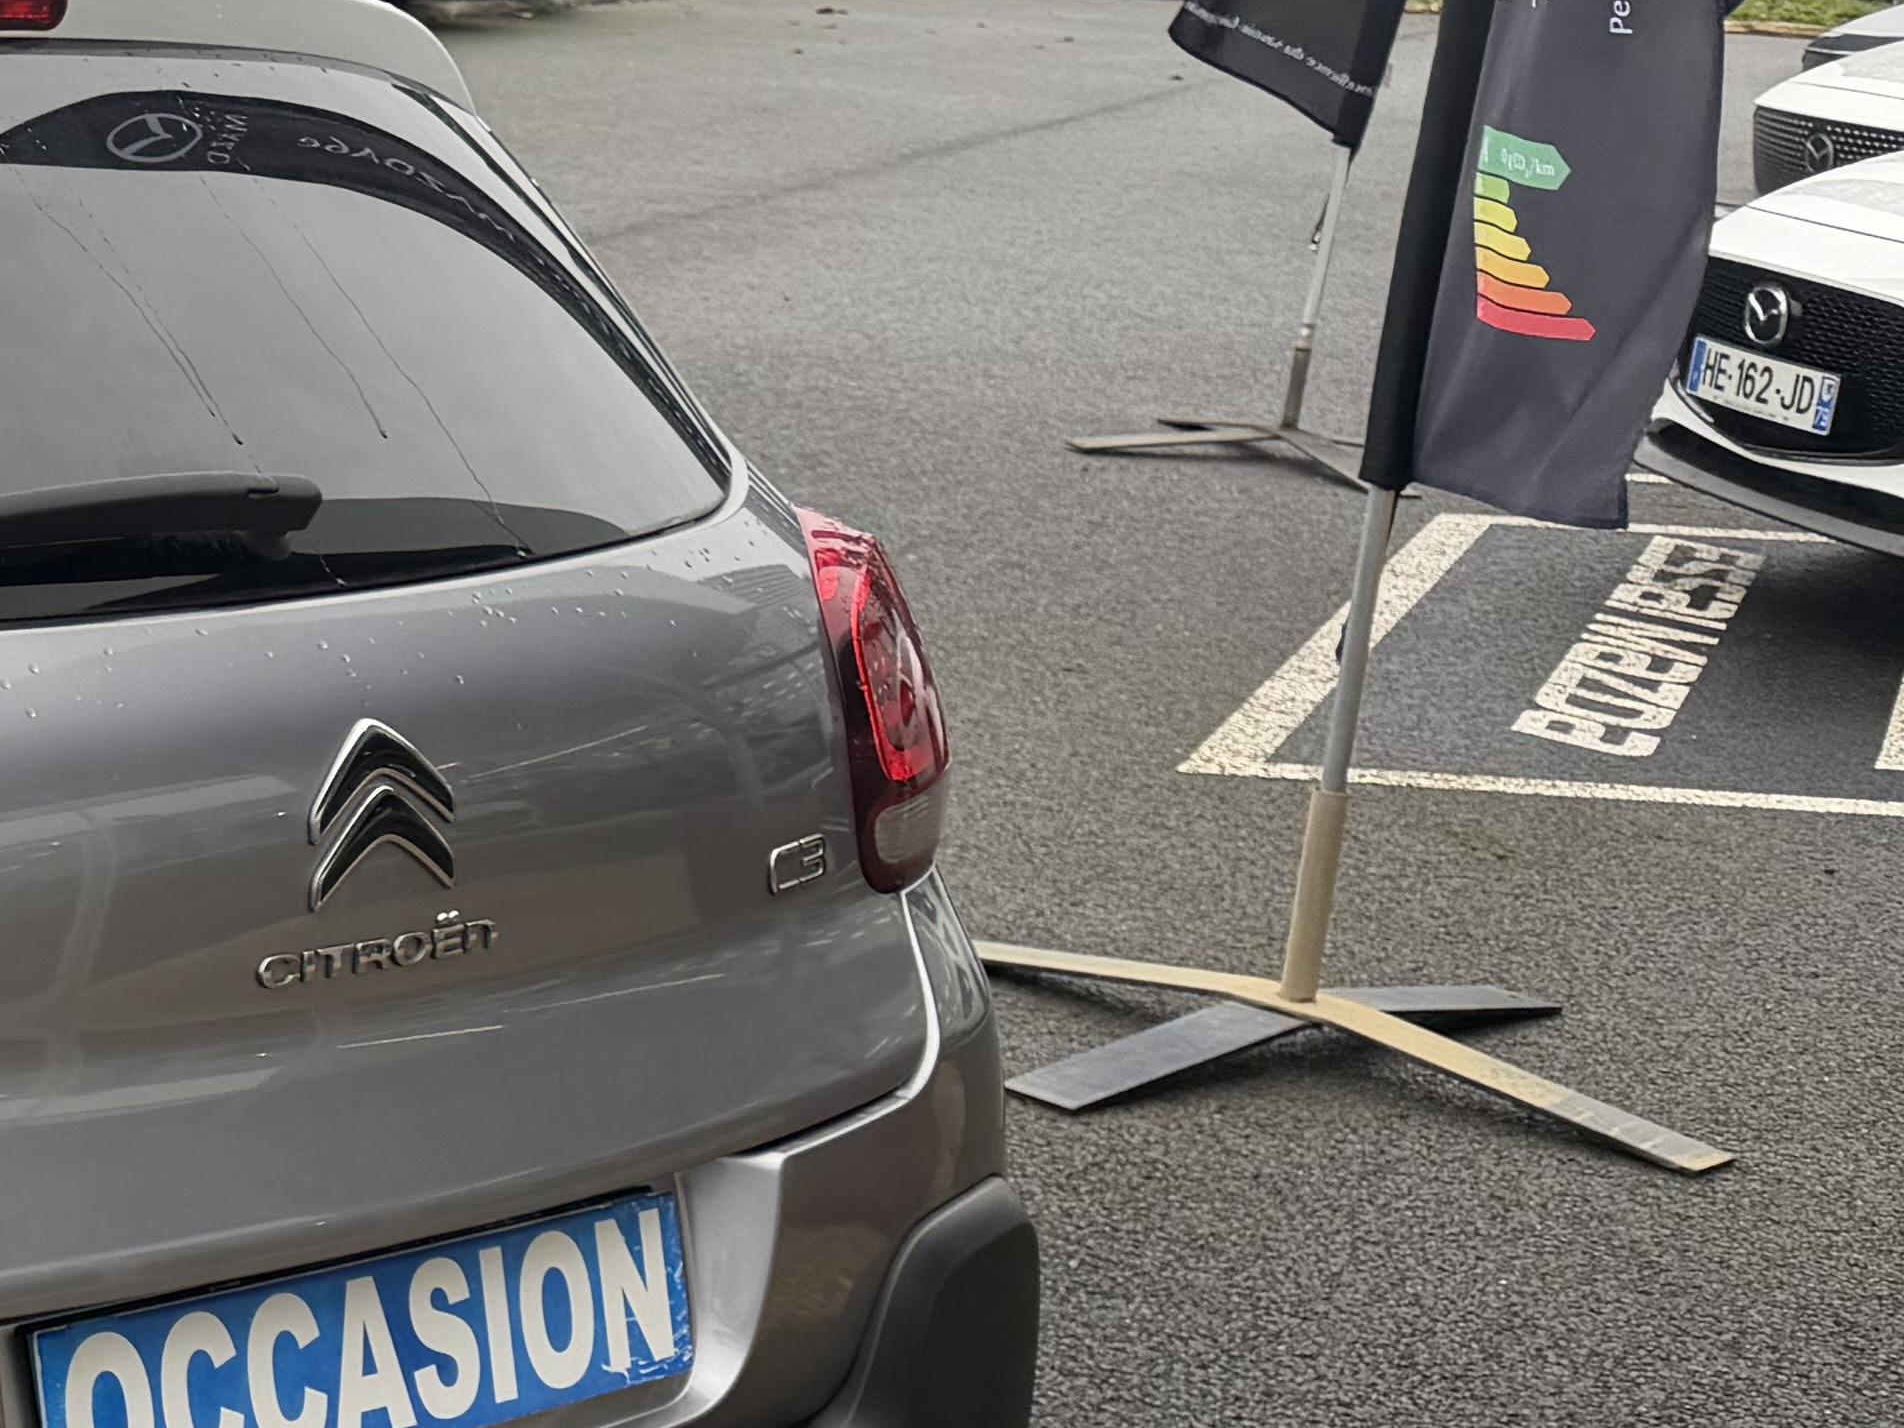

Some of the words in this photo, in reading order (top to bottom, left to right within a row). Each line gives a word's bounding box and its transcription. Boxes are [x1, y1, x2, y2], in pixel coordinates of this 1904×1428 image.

[1702, 347, 1815, 415] HE-162-JD
[768, 832, 828, 895] C3
[256, 909, 500, 990] CITROËN
